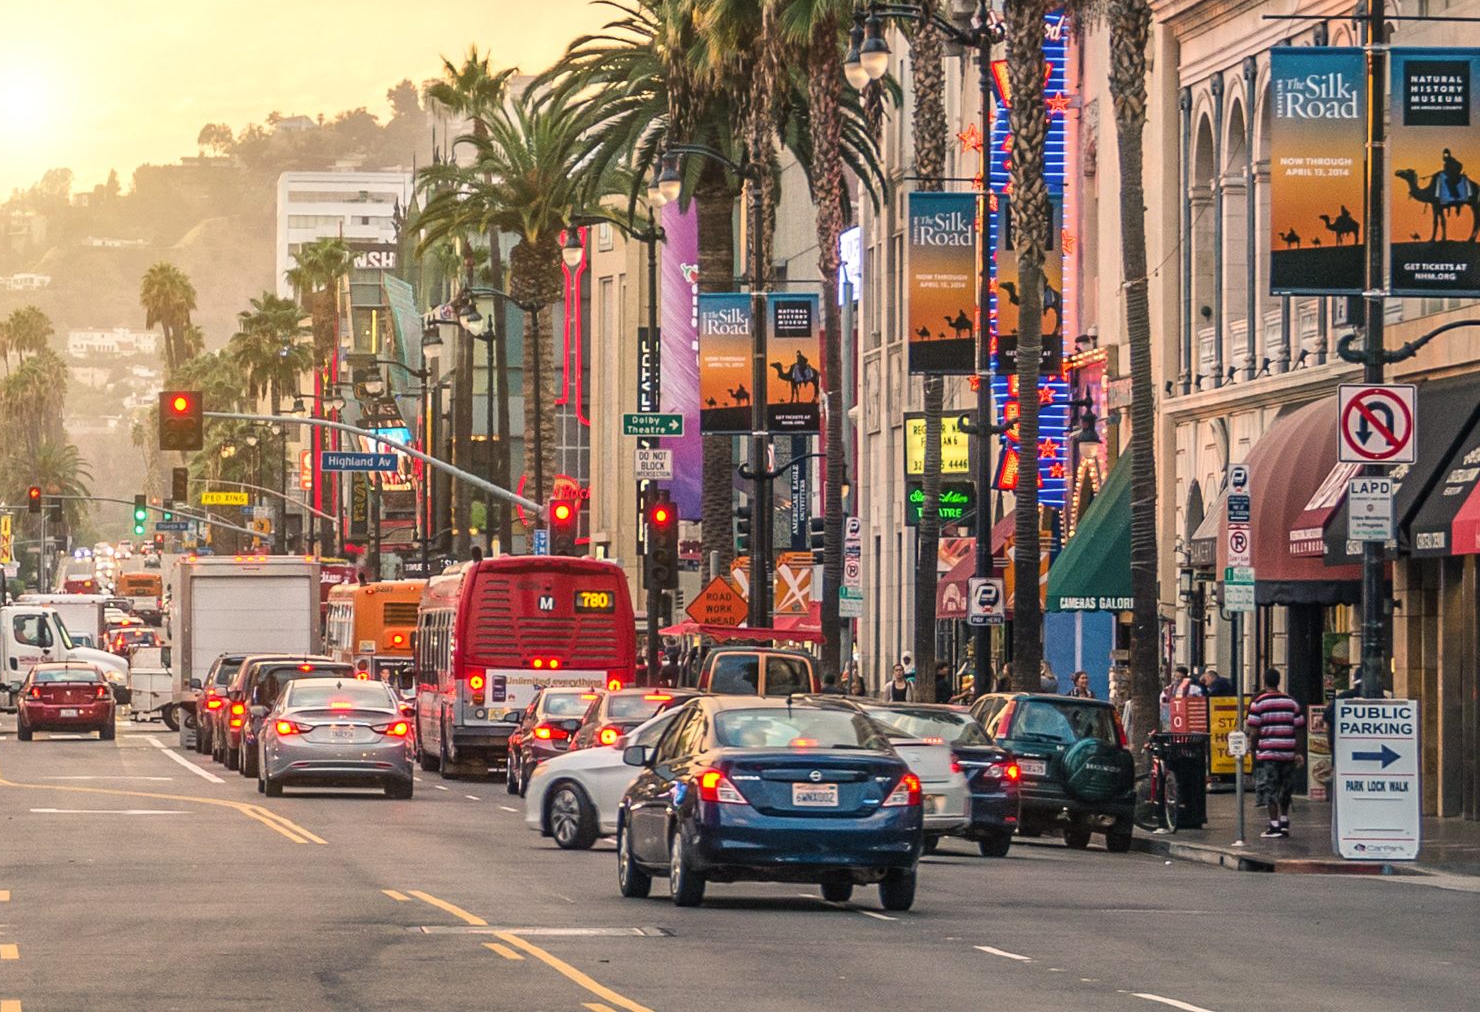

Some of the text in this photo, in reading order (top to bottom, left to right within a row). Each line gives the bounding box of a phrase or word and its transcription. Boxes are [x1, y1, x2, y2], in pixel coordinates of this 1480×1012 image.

[1286, 73, 1350, 99] The Silk
[1411, 76, 1463, 84] NATURAL
[1285, 90, 1358, 119] Road
[1411, 95, 1463, 103] MUSEUM
[1280, 158, 1353, 166] NOW THROUGH
[1285, 168, 1312, 176] APRIL
[1327, 168, 1349, 176] 2014
[920, 212, 967, 232] The Silk
[920, 224, 973, 247] Road
[1404, 263, 1467, 271] GET TICKETS AT
[1415, 272, 1456, 281] NHM.ORG
[719, 308, 745, 324] Silk
[708, 318, 749, 335] Road
[632, 415, 660, 427] Dolby
[627, 426, 666, 434] Theatre
[328, 456, 392, 468] Highland Av
[639, 452, 667, 460] DO NOT
[641, 461, 664, 470] BLOCK
[1351, 482, 1389, 494] LAPD
[205, 494, 245, 503] PED XING
[580, 592, 608, 607] 780
[706, 593, 732, 601] ROAD
[1060, 597, 1096, 609] CAMERAS
[706, 605, 732, 613] WORK
[704, 617, 735, 625] AHEAD
[507, 676, 605, 688] Unlimited everything.
[1341, 707, 1412, 719] PUBLIC
[1340, 722, 1413, 735] PARKING
[1346, 780, 1409, 792] PARK LOCK WALK
